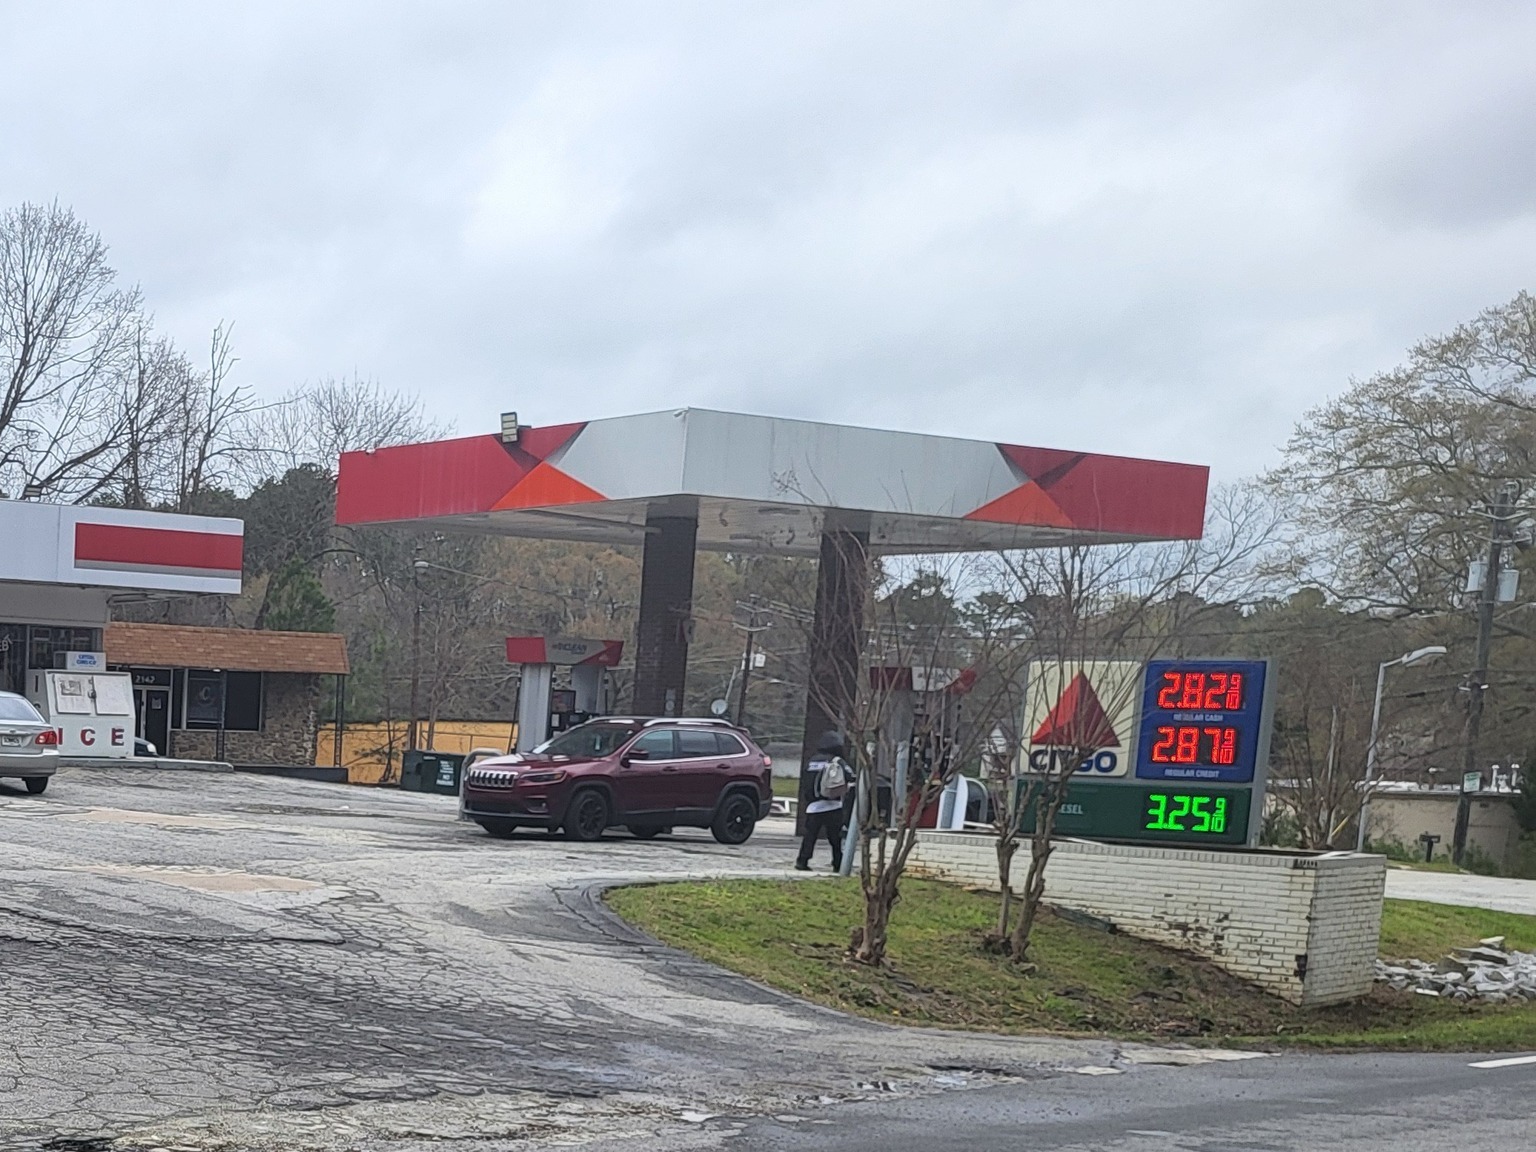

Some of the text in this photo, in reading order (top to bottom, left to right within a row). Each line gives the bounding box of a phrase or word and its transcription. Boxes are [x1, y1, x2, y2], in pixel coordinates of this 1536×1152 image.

[1158, 673, 1227, 709] 2.82
[57, 727, 125, 746] ICE
[1152, 727, 1221, 764] 2.87
